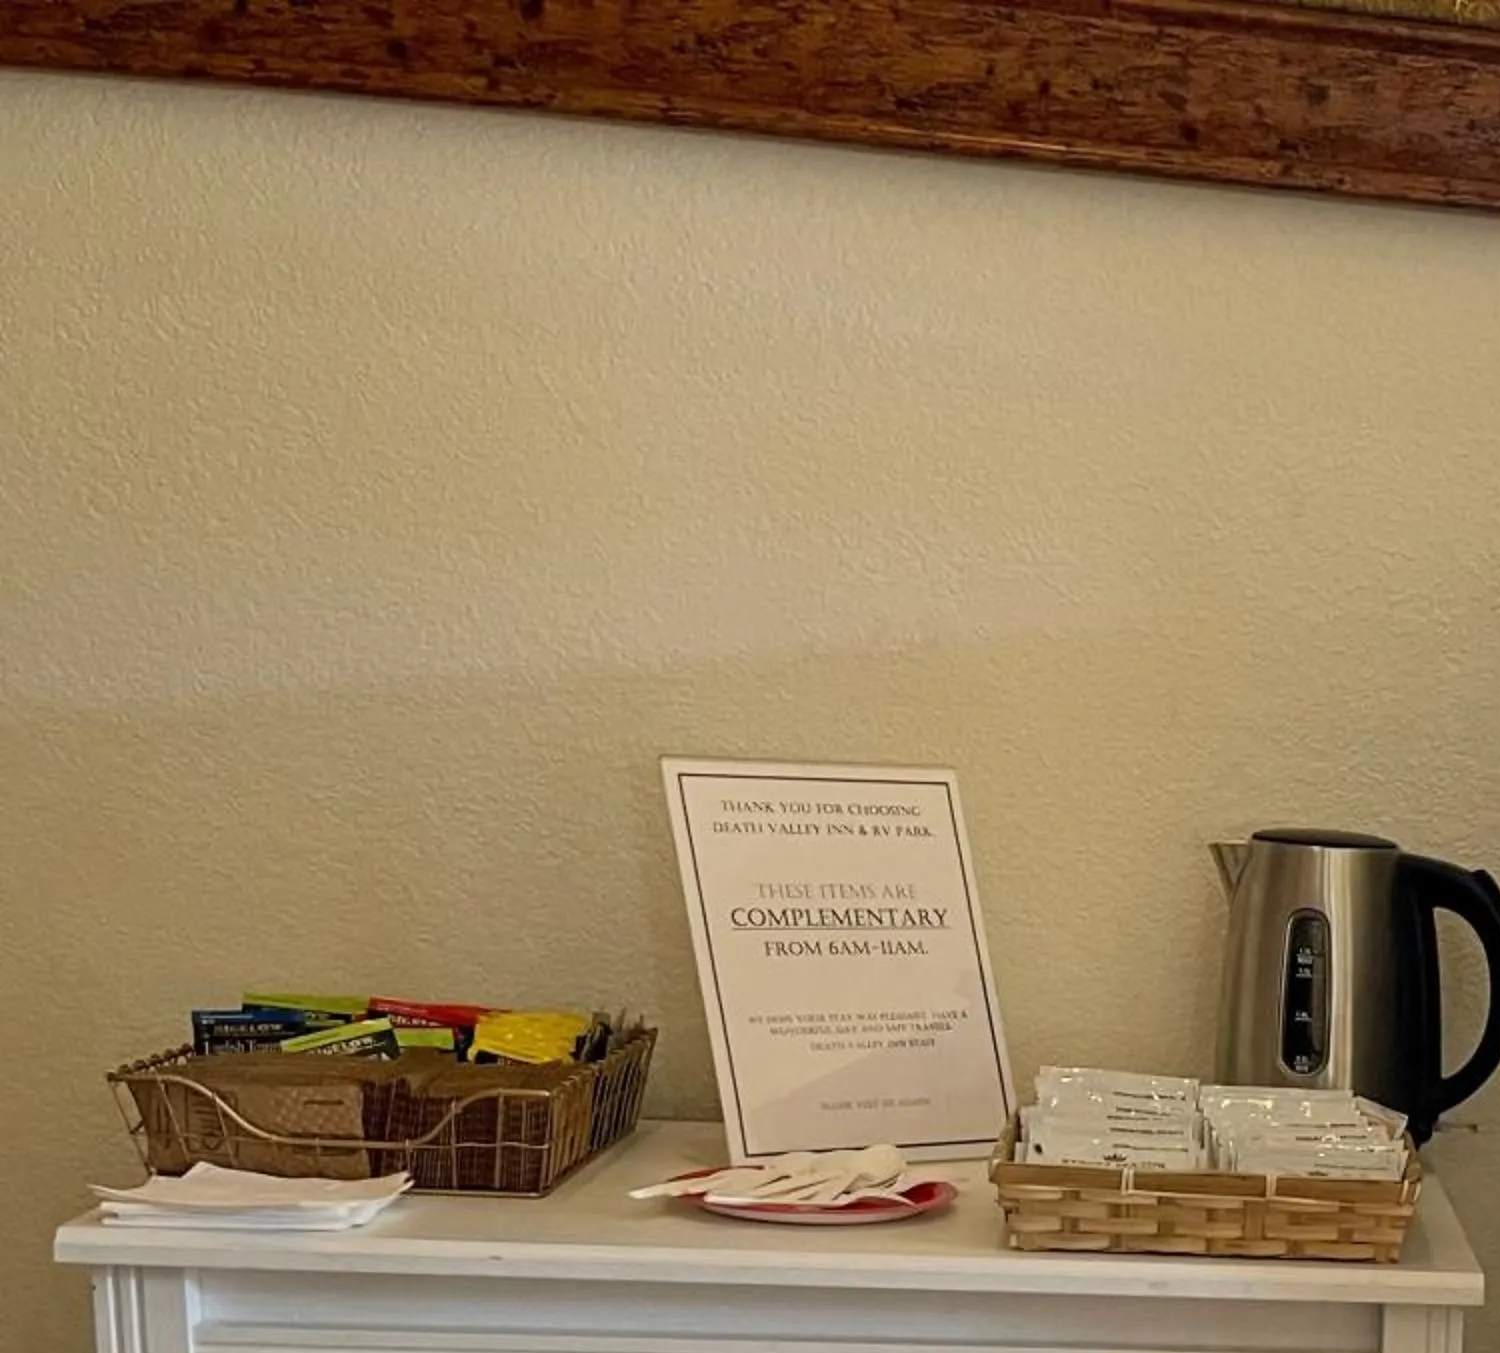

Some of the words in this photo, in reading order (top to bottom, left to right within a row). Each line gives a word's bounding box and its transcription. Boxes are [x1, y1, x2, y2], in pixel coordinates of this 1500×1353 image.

[721, 799, 774, 814] THANK
[779, 801, 811, 815] YOU
[816, 802, 843, 815] FOR
[847, 803, 921, 817] CHOOSING
[713, 821, 763, 835] DEATH
[768, 822, 820, 836] VALLEY
[826, 823, 854, 836] INN
[858, 824, 868, 837] &
[872, 824, 890, 837] RV
[757, 882, 812, 900] THESE
[819, 883, 877, 900] ITEMS
[881, 883, 916, 900] ARE
[731, 906, 949, 928] COMPLEMENTARY
[764, 940, 823, 957] FROM
